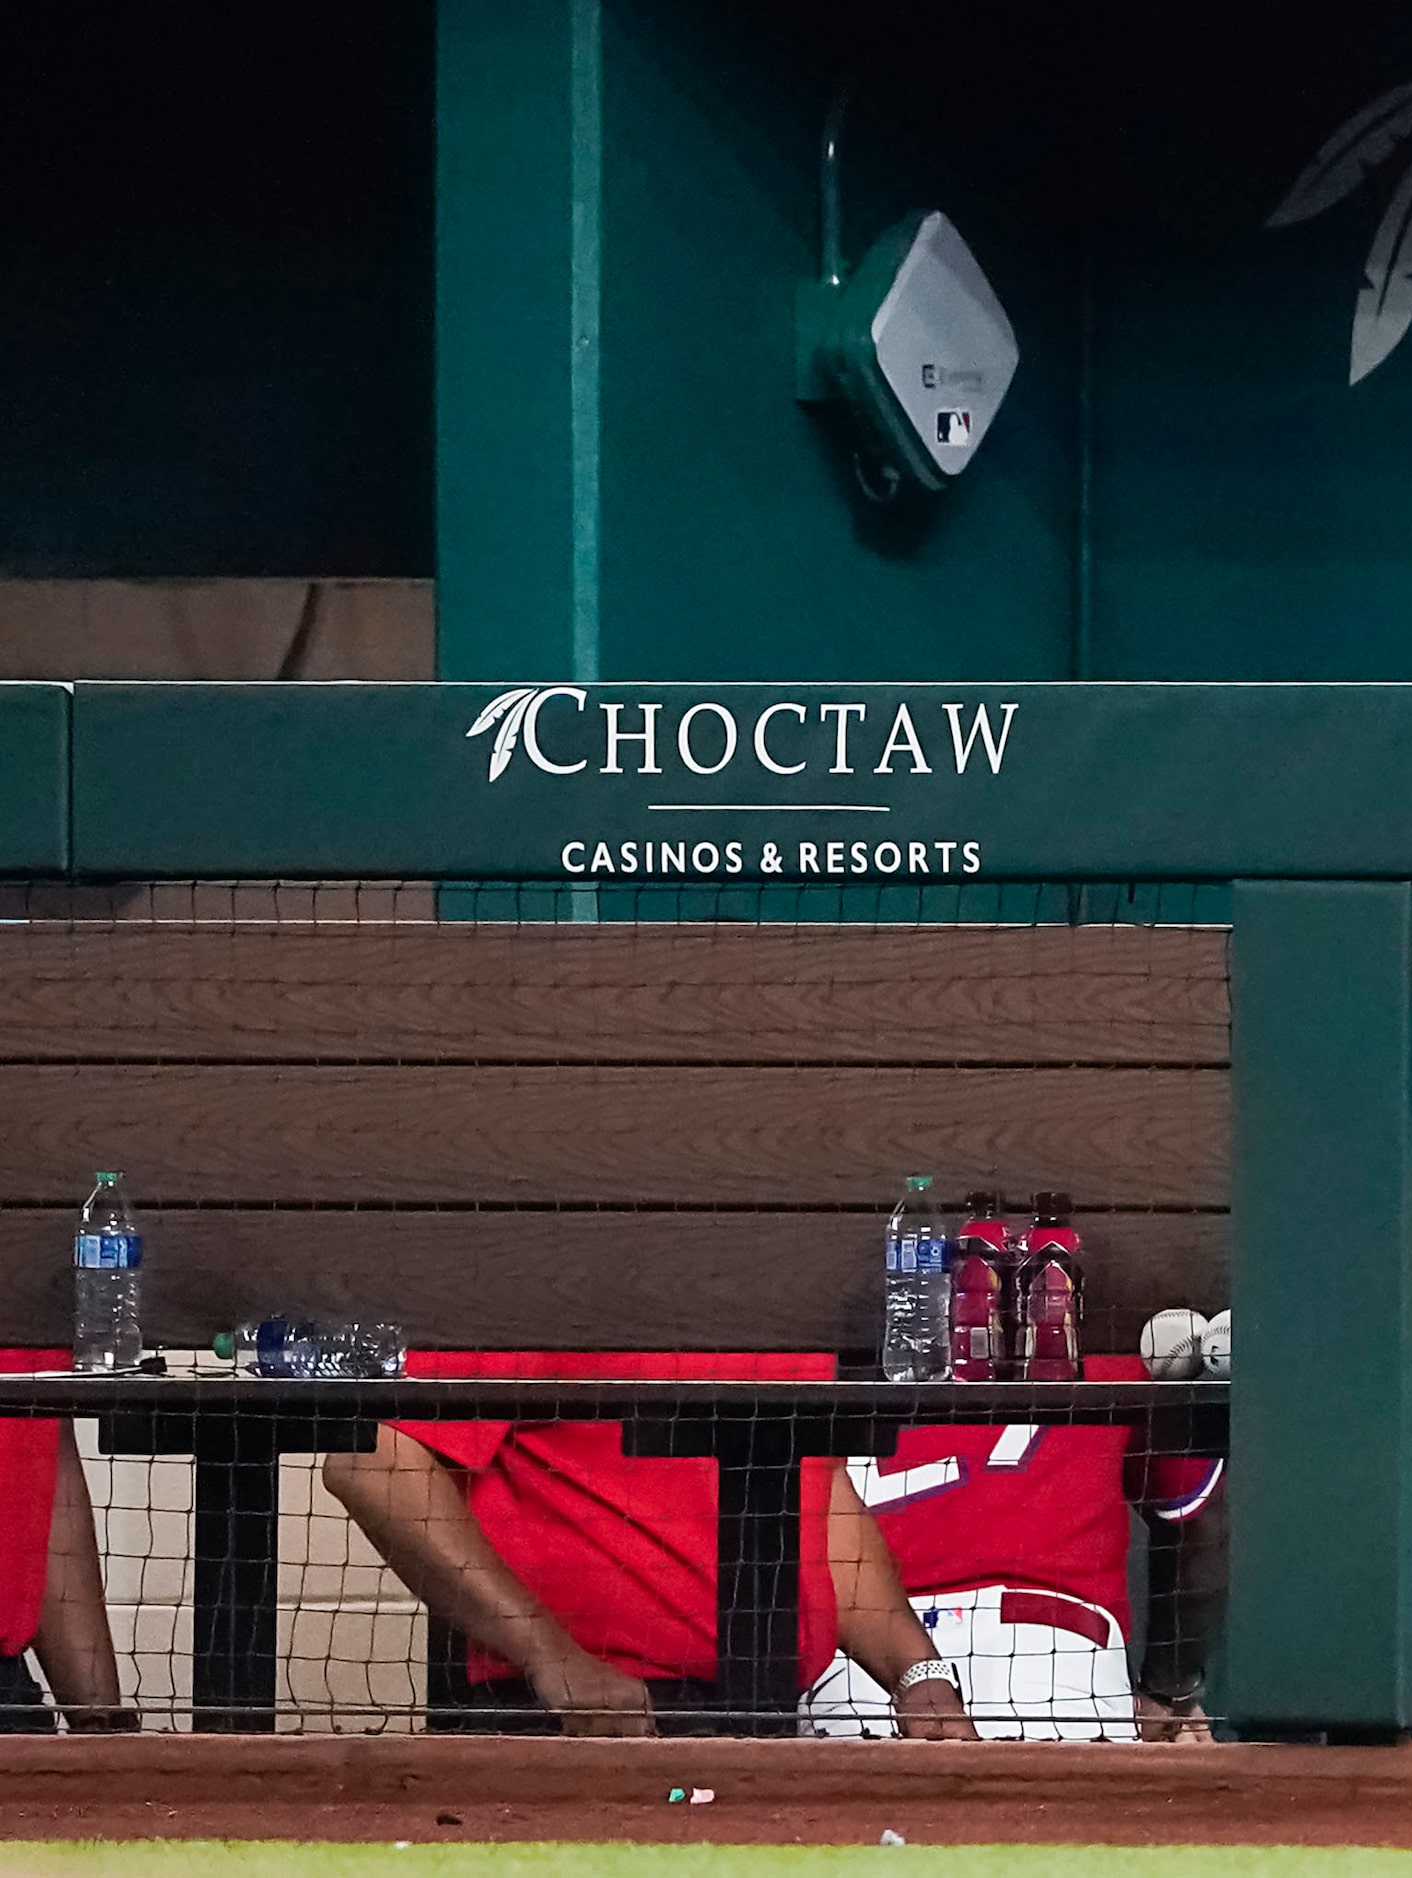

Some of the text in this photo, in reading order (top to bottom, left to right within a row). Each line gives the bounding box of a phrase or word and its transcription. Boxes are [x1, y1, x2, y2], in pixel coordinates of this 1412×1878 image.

[522, 686, 1019, 775] CHOCTAW
[561, 841, 980, 874] CASINOS & RESORTS
